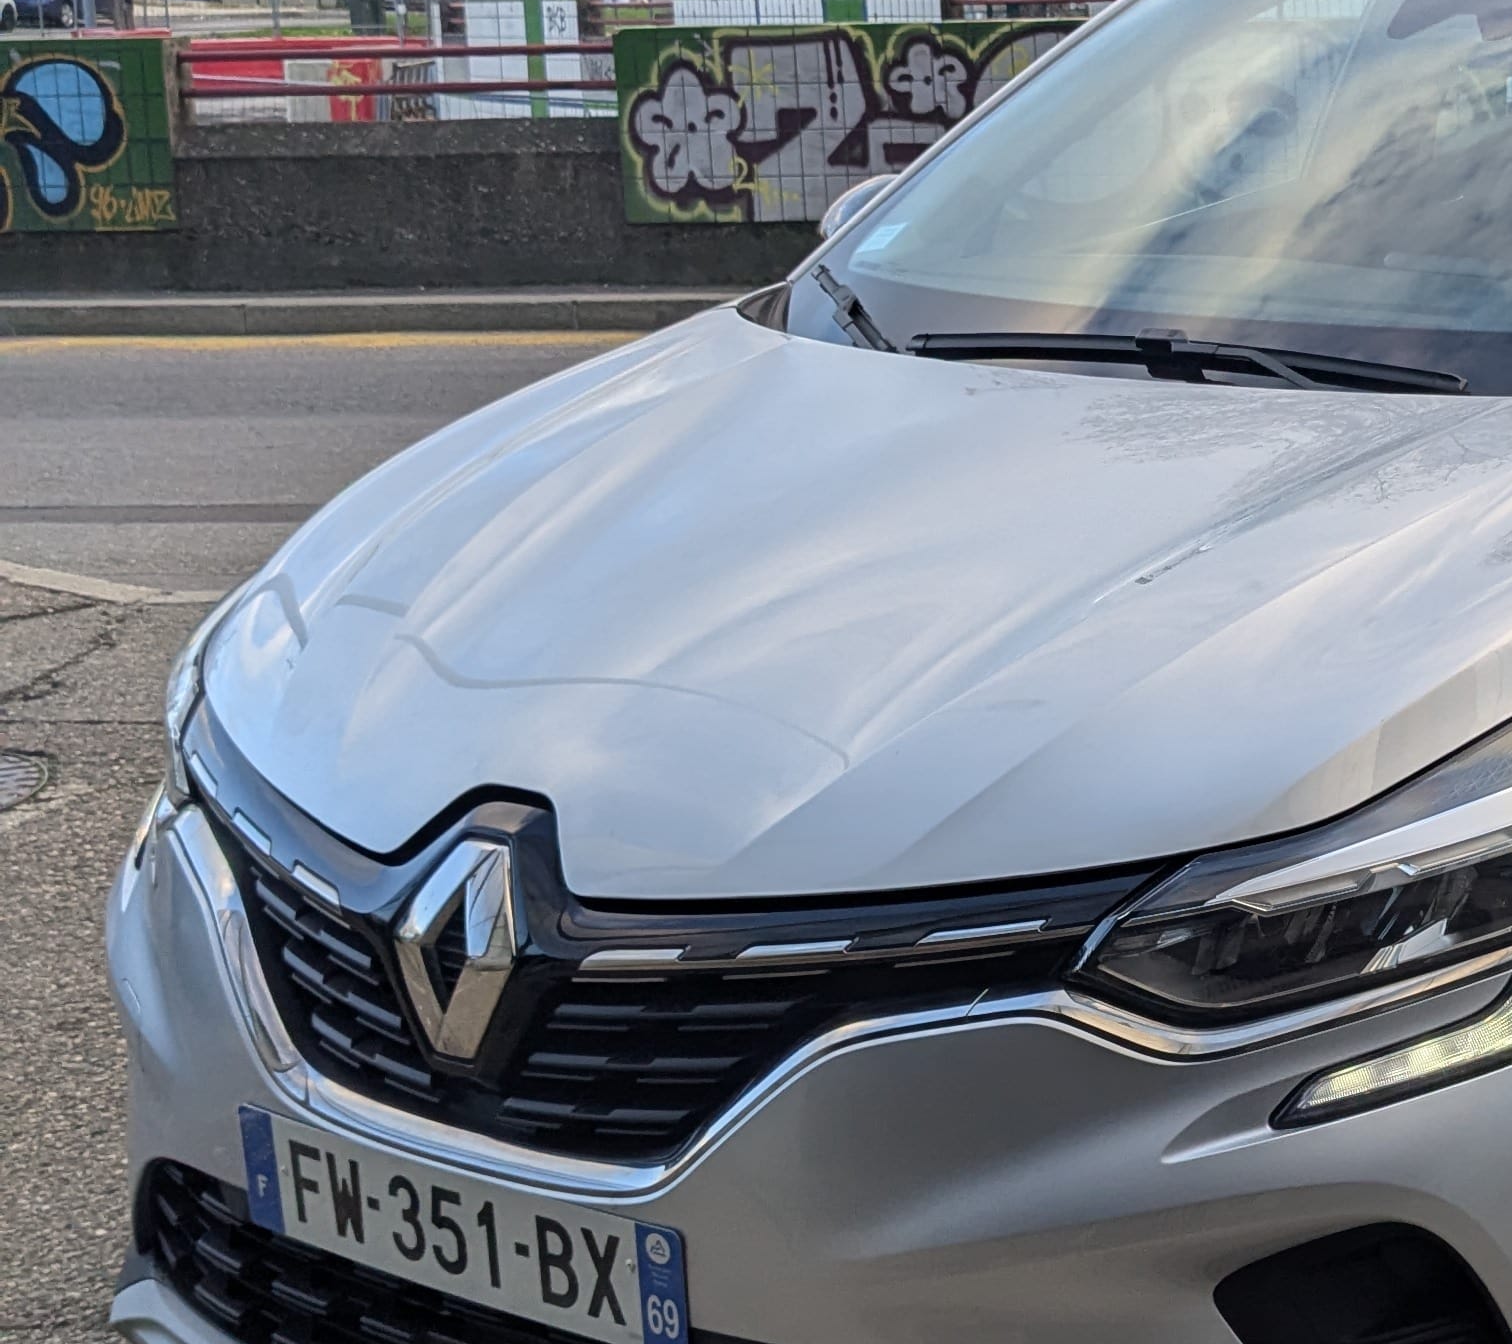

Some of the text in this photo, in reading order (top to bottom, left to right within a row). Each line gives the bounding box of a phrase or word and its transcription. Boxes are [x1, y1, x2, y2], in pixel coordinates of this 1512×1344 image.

[257, 1174, 268, 1198] F
[288, 1139, 627, 1327] FW-351-BX
[647, 1294, 680, 1340] 69
